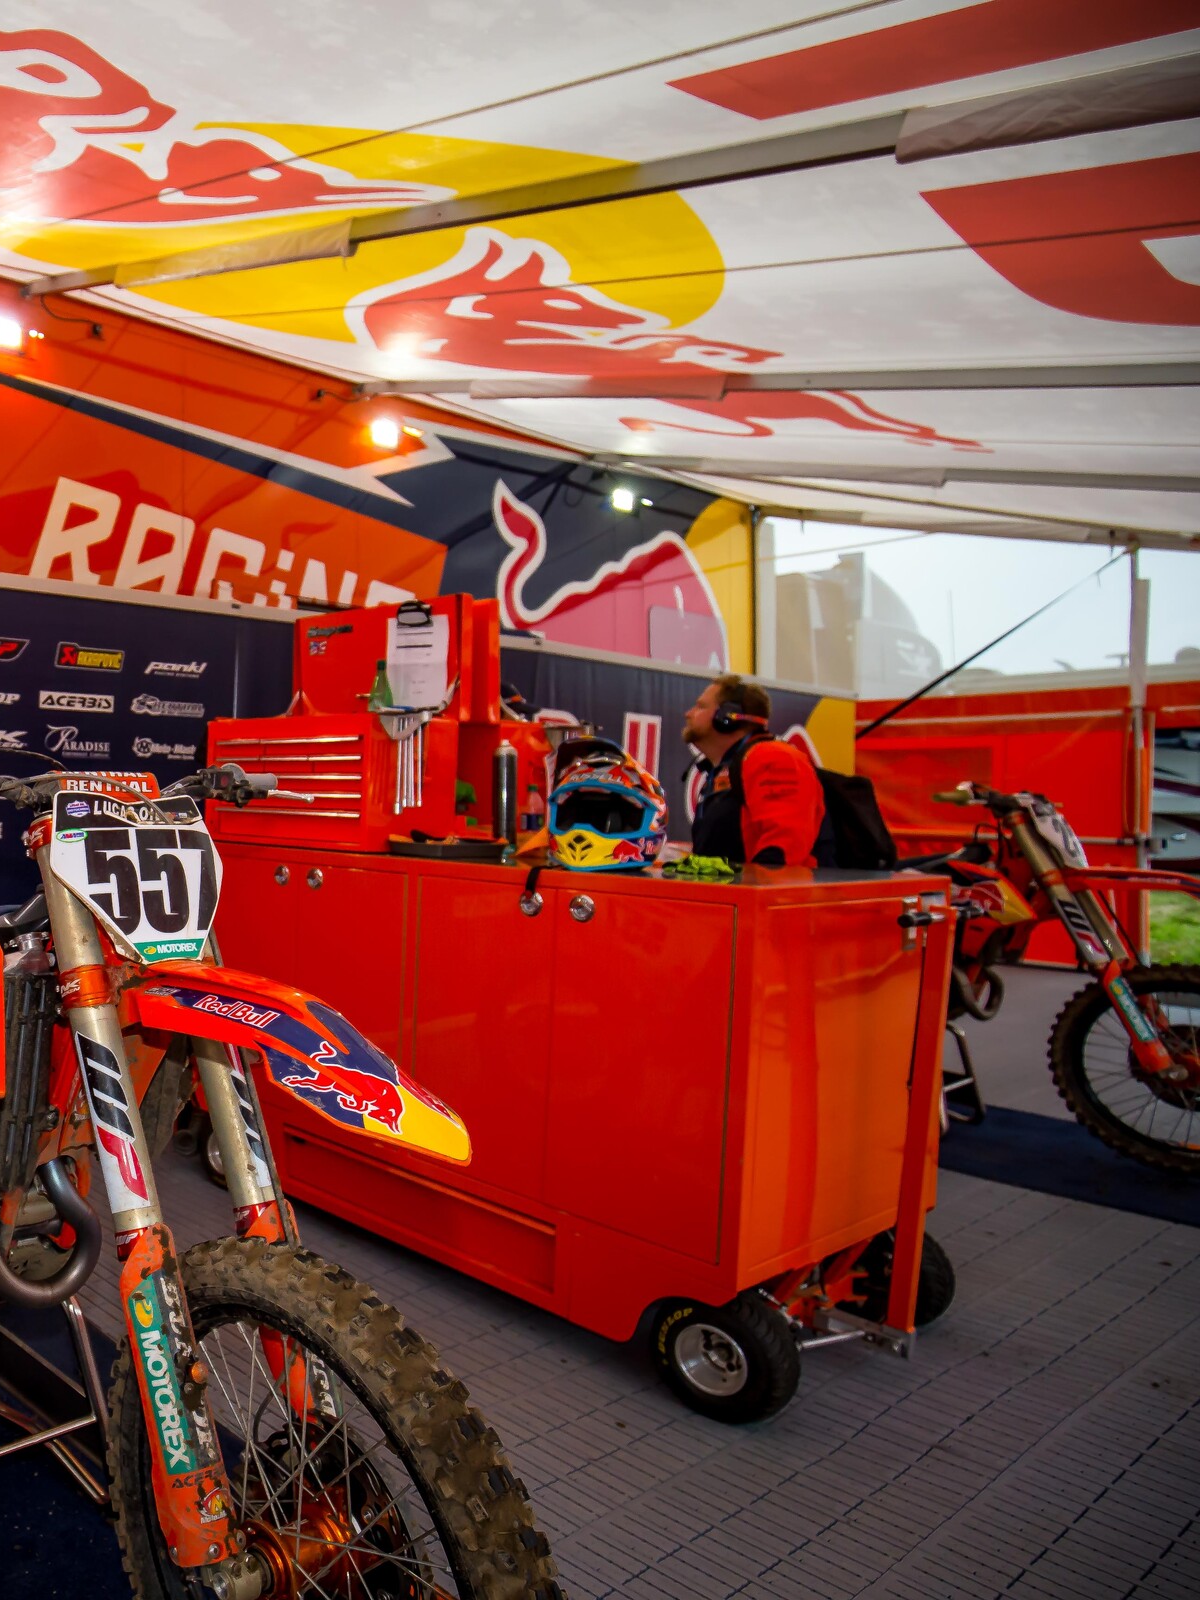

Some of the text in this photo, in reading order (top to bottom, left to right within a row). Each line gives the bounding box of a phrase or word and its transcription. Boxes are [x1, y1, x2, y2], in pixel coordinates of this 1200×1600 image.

[42, 695, 112, 709] ACERBIS
[45, 724, 111, 752] PARADISE
[85, 829, 218, 936] 557
[156, 943, 198, 954] MOTOREX
[193, 994, 280, 1028] Red Bull
[658, 1307, 693, 1354] DUNLOP
[140, 1329, 190, 1468] MOTOREX
